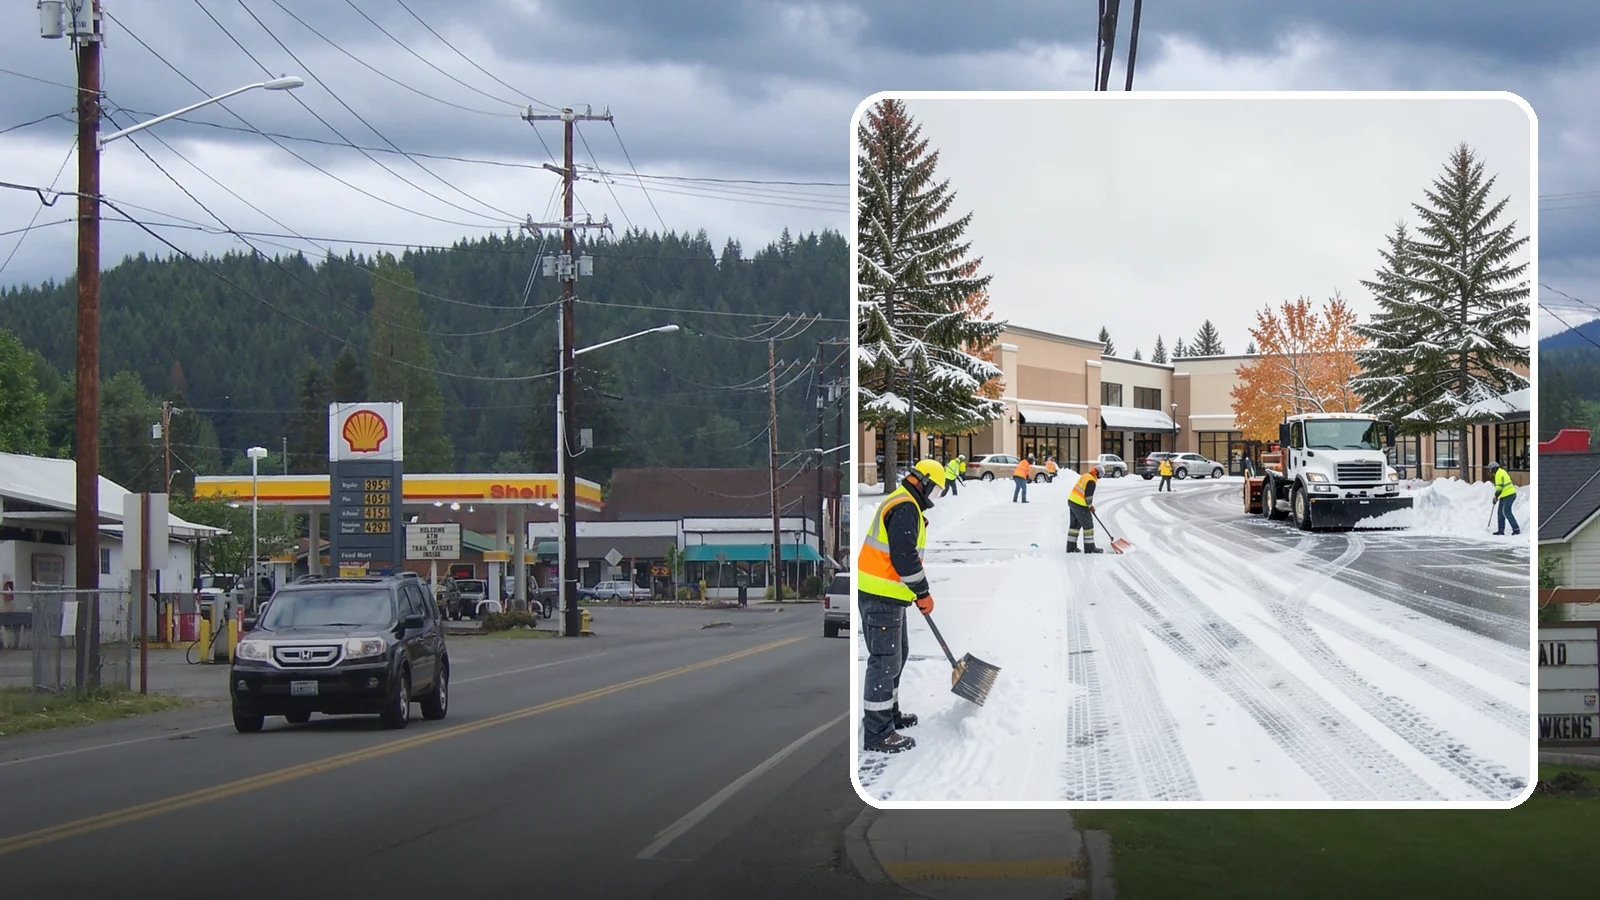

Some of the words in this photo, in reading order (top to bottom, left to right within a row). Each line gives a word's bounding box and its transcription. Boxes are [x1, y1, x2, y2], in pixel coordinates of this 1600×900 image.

[366, 480, 383, 490] 395
[490, 484, 547, 499] Shell
[366, 494, 383, 504] 405
[365, 508, 383, 518] 415
[366, 522, 383, 532] 429
[1538, 643, 1567, 665] AID
